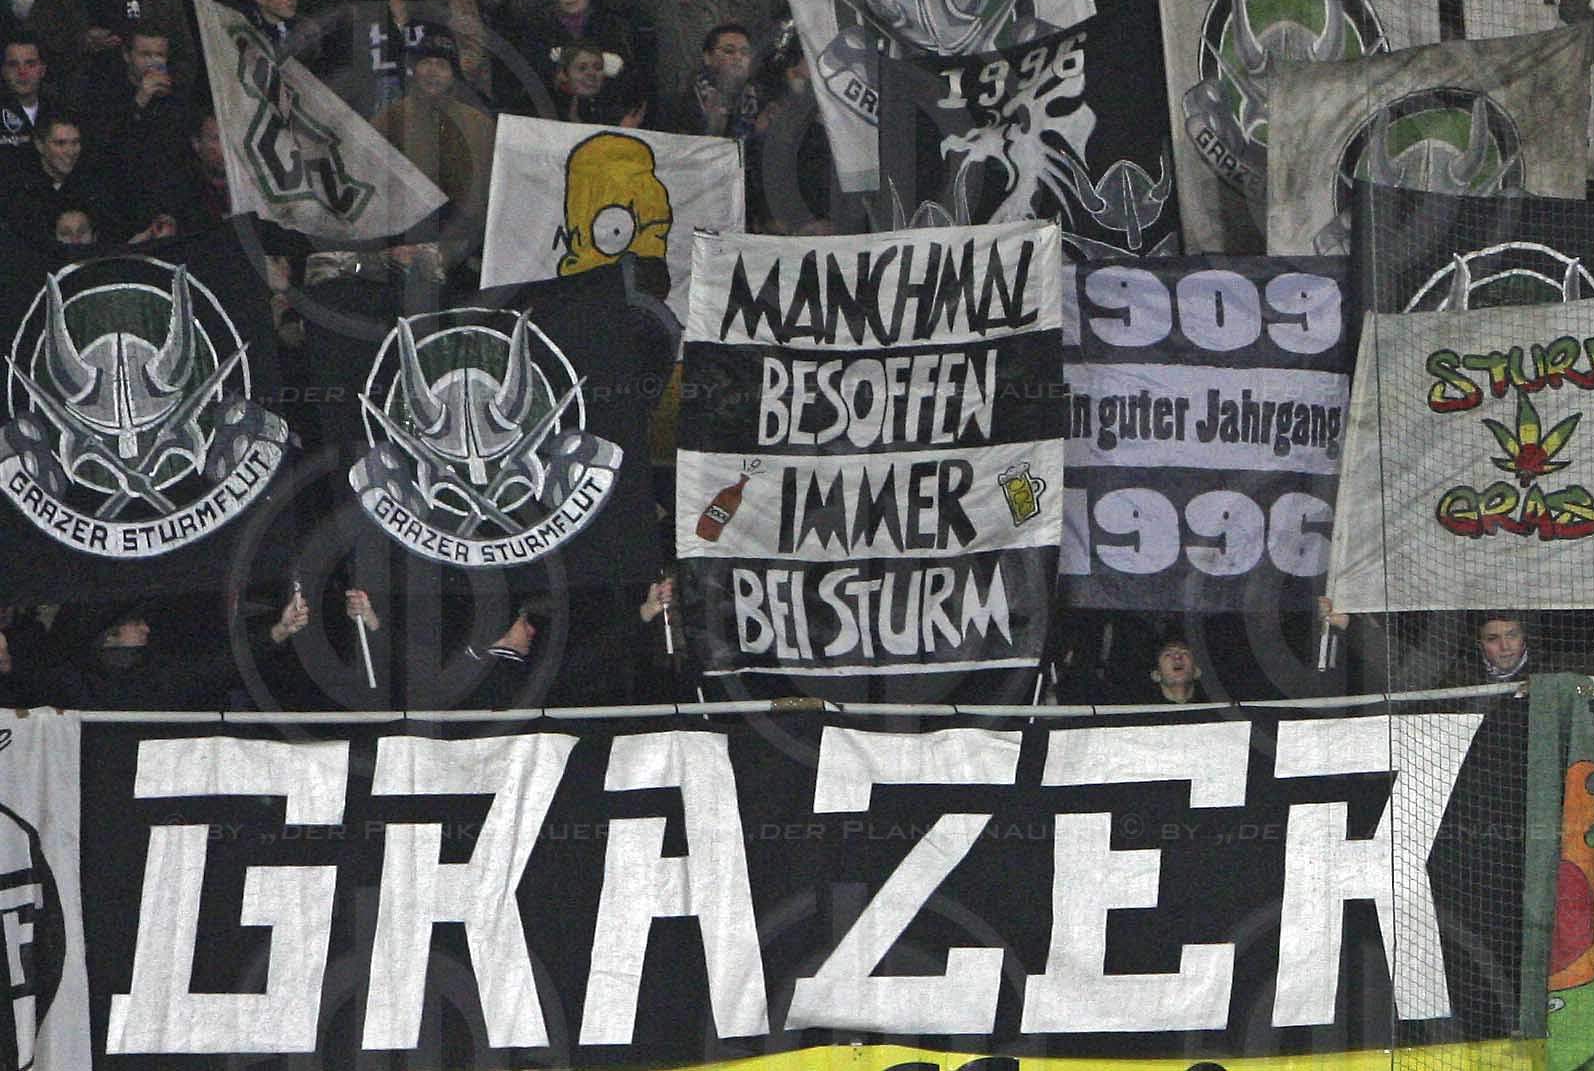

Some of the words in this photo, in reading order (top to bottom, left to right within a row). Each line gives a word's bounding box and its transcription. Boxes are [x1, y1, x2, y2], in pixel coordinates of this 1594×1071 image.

[936, 30, 1088, 110] 1996
[719, 239, 1042, 348] MANCHMAL
[1062, 264, 1344, 356] 1909
[757, 348, 998, 447] BESOFFEN
[1097, 388, 1191, 452] guter
[1197, 386, 1342, 468] Jahrgang
[8, 468, 109, 552] GRAZER
[121, 451, 275, 553] STURMFLUT
[372, 496, 470, 565] GRAZER
[480, 477, 606, 564] STURMFLUT
[776, 457, 979, 555] IMMER
[1060, 485, 1332, 578] 1996
[732, 566, 816, 660] BEI
[817, 560, 1015, 659] STURM
[105, 712, 1484, 1055] GRAZER
